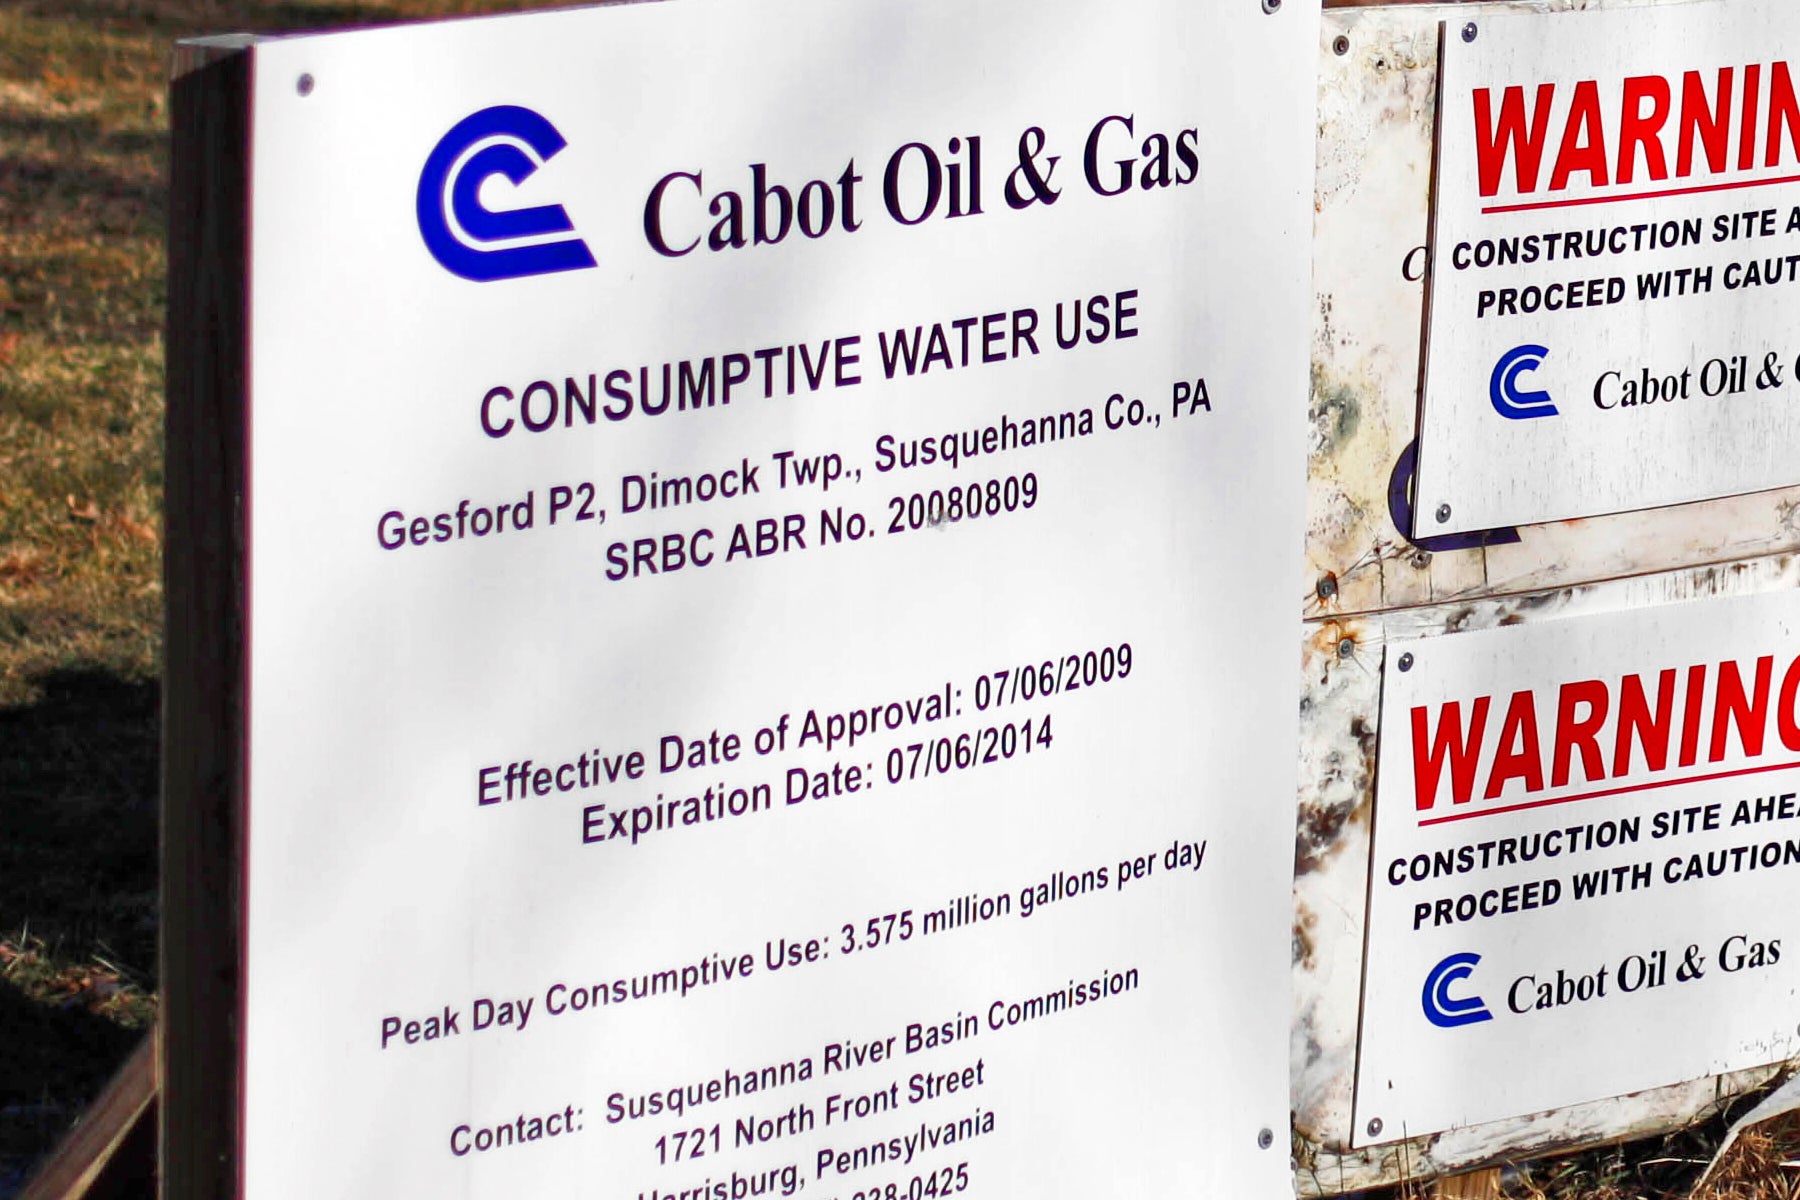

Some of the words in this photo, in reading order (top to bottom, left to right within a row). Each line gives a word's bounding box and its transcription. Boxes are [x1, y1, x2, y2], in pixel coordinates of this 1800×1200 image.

[642, 157, 864, 258] Cabot
[882, 135, 985, 226] Oil
[1003, 125, 1063, 211] &
[1083, 113, 1199, 197] Gas
[1451, 217, 1703, 271] CONSTRUCTION
[1711, 208, 1778, 243] SITE
[1476, 276, 1626, 319] PROCEED
[1636, 265, 1714, 302] WITH
[479, 334, 862, 439] CONSUMPTIVE
[877, 307, 1041, 380] WATER
[1055, 288, 1139, 351] USE
[1592, 365, 1692, 410] Cabot
[1699, 355, 1748, 397] Oil
[1756, 351, 1784, 390] &
[376, 490, 535, 551] Gesford
[548, 481, 606, 526] P2,
[621, 457, 760, 515] Dimock
[771, 450, 862, 492] Twp.,
[874, 408, 1094, 473] Susquehanna
[1104, 392, 1161, 431] Co.,
[1172, 378, 1212, 419] PA
[604, 528, 715, 582] SRBC
[724, 513, 807, 563] ABR
[820, 506, 875, 547] No.
[887, 471, 1038, 535] 20080809
[478, 748, 646, 807] Effective
[659, 729, 741, 775] Date
[754, 714, 790, 755] of
[797, 681, 962, 753] Approval:
[974, 642, 1133, 712] 07/06/2009
[582, 781, 771, 846] Expiration
[785, 761, 873, 806] Date:
[886, 713, 1054, 785] 07/06/2014
[1387, 817, 1641, 886] CONSTRUCTION
[1650, 802, 1722, 840] SITE
[1413, 878, 1562, 931] PROCEED
[1572, 861, 1653, 901] WITH
[381, 1005, 461, 1050] Peak
[472, 996, 535, 1032] Day
[545, 952, 755, 1016] Consumptive
[765, 936, 830, 971] Use:
[840, 909, 914, 955] 3.575
[923, 893, 1011, 936] million
[1019, 866, 1109, 919] gallons
[1117, 853, 1157, 890] per
[1164, 840, 1207, 870] day
[1507, 963, 1609, 1015] Cabot
[1616, 949, 1667, 993] Oil
[1675, 944, 1706, 982] &
[1718, 934, 1781, 973] Gas
[449, 1104, 583, 1157] Contact:
[606, 1057, 813, 1124] Susquehanna
[823, 1036, 897, 1076] River
[905, 1011, 979, 1055] Basin
[987, 967, 1139, 1031] Commission
[654, 1123, 721, 1166] 1721
[735, 1103, 815, 1149] North
[825, 1081, 899, 1126] Front
[907, 1057, 985, 1105] Street
[817, 1107, 995, 1180] Pennsylvania
